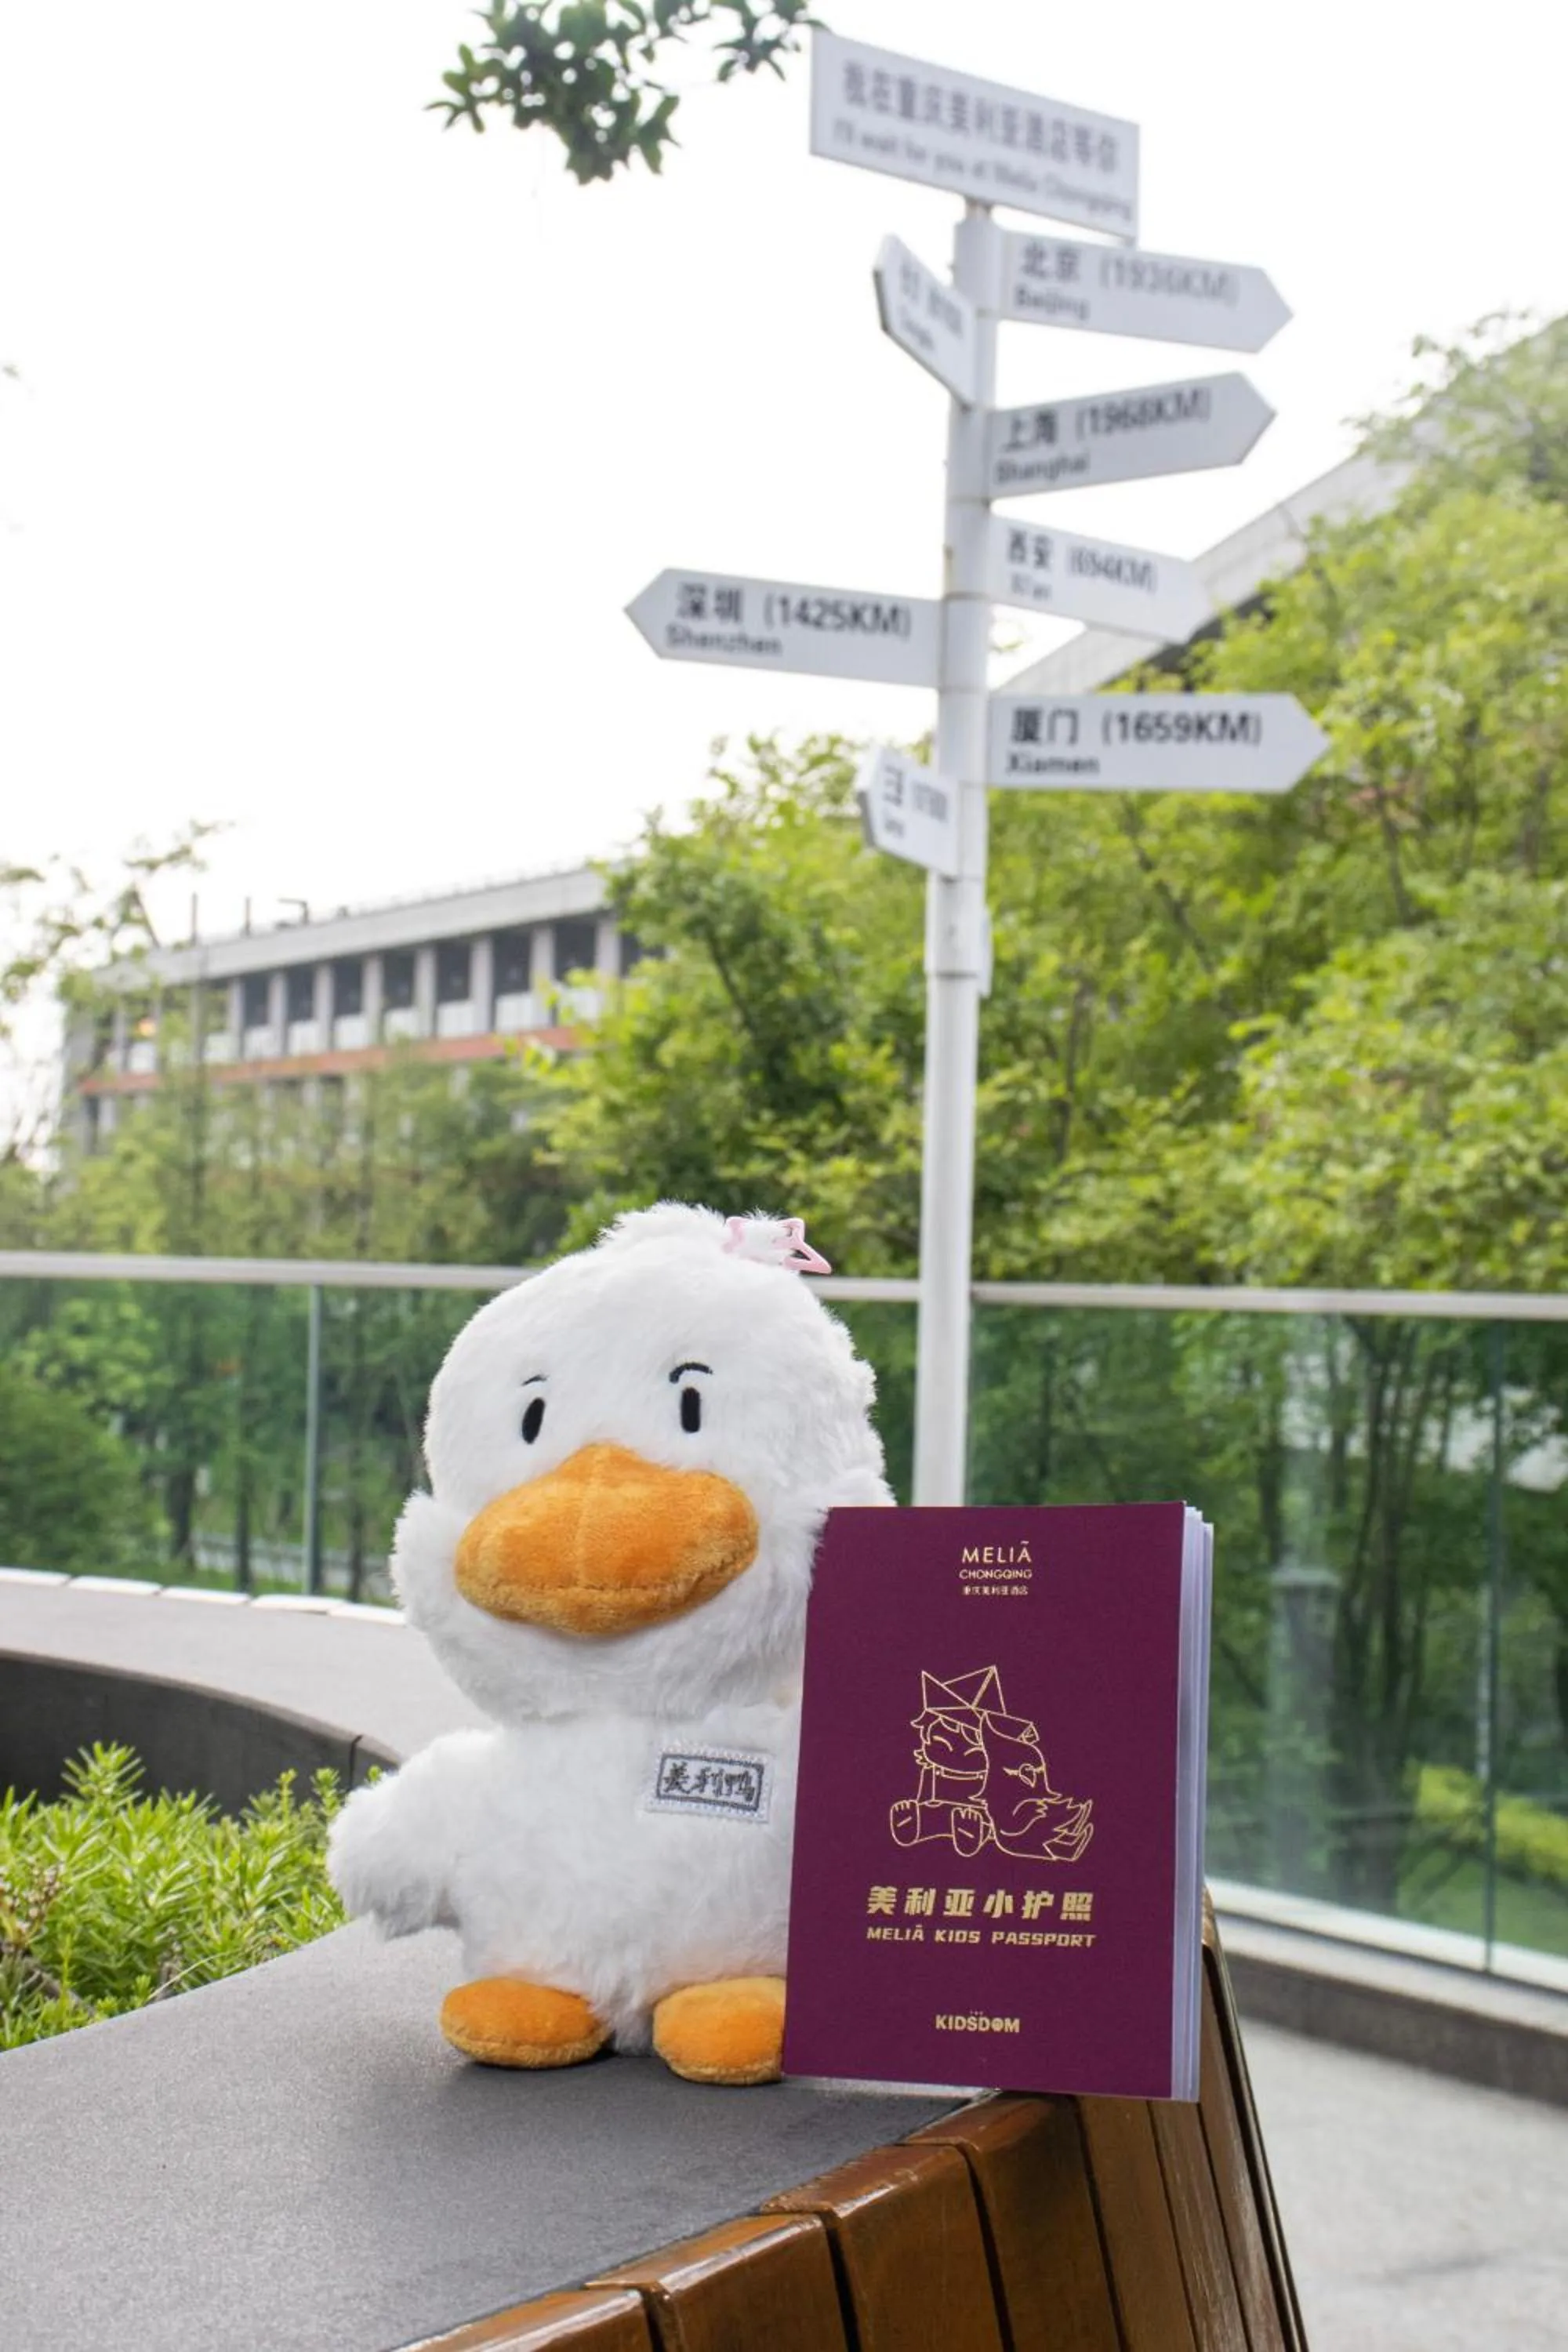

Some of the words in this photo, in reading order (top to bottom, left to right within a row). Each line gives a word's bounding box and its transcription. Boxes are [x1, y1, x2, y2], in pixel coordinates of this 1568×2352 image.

[1022, 242, 1081, 282] 北京
[1014, 285, 1091, 322] Beijing
[1000, 409, 1058, 452] 上海
[995, 454, 1091, 485] Shanghai
[676, 583, 744, 624] 深圳
[666, 624, 783, 655] Shenzhen
[1011, 706, 1080, 746] 厦门
[1006, 751, 1101, 774] Xiamen
[959, 1569, 1033, 1580] CHONGQING
[866, 1886, 1094, 1922] 美利亚小护照
[935, 1929, 981, 1944] KIDS
[991, 1931, 1097, 1948] PASSPORT
